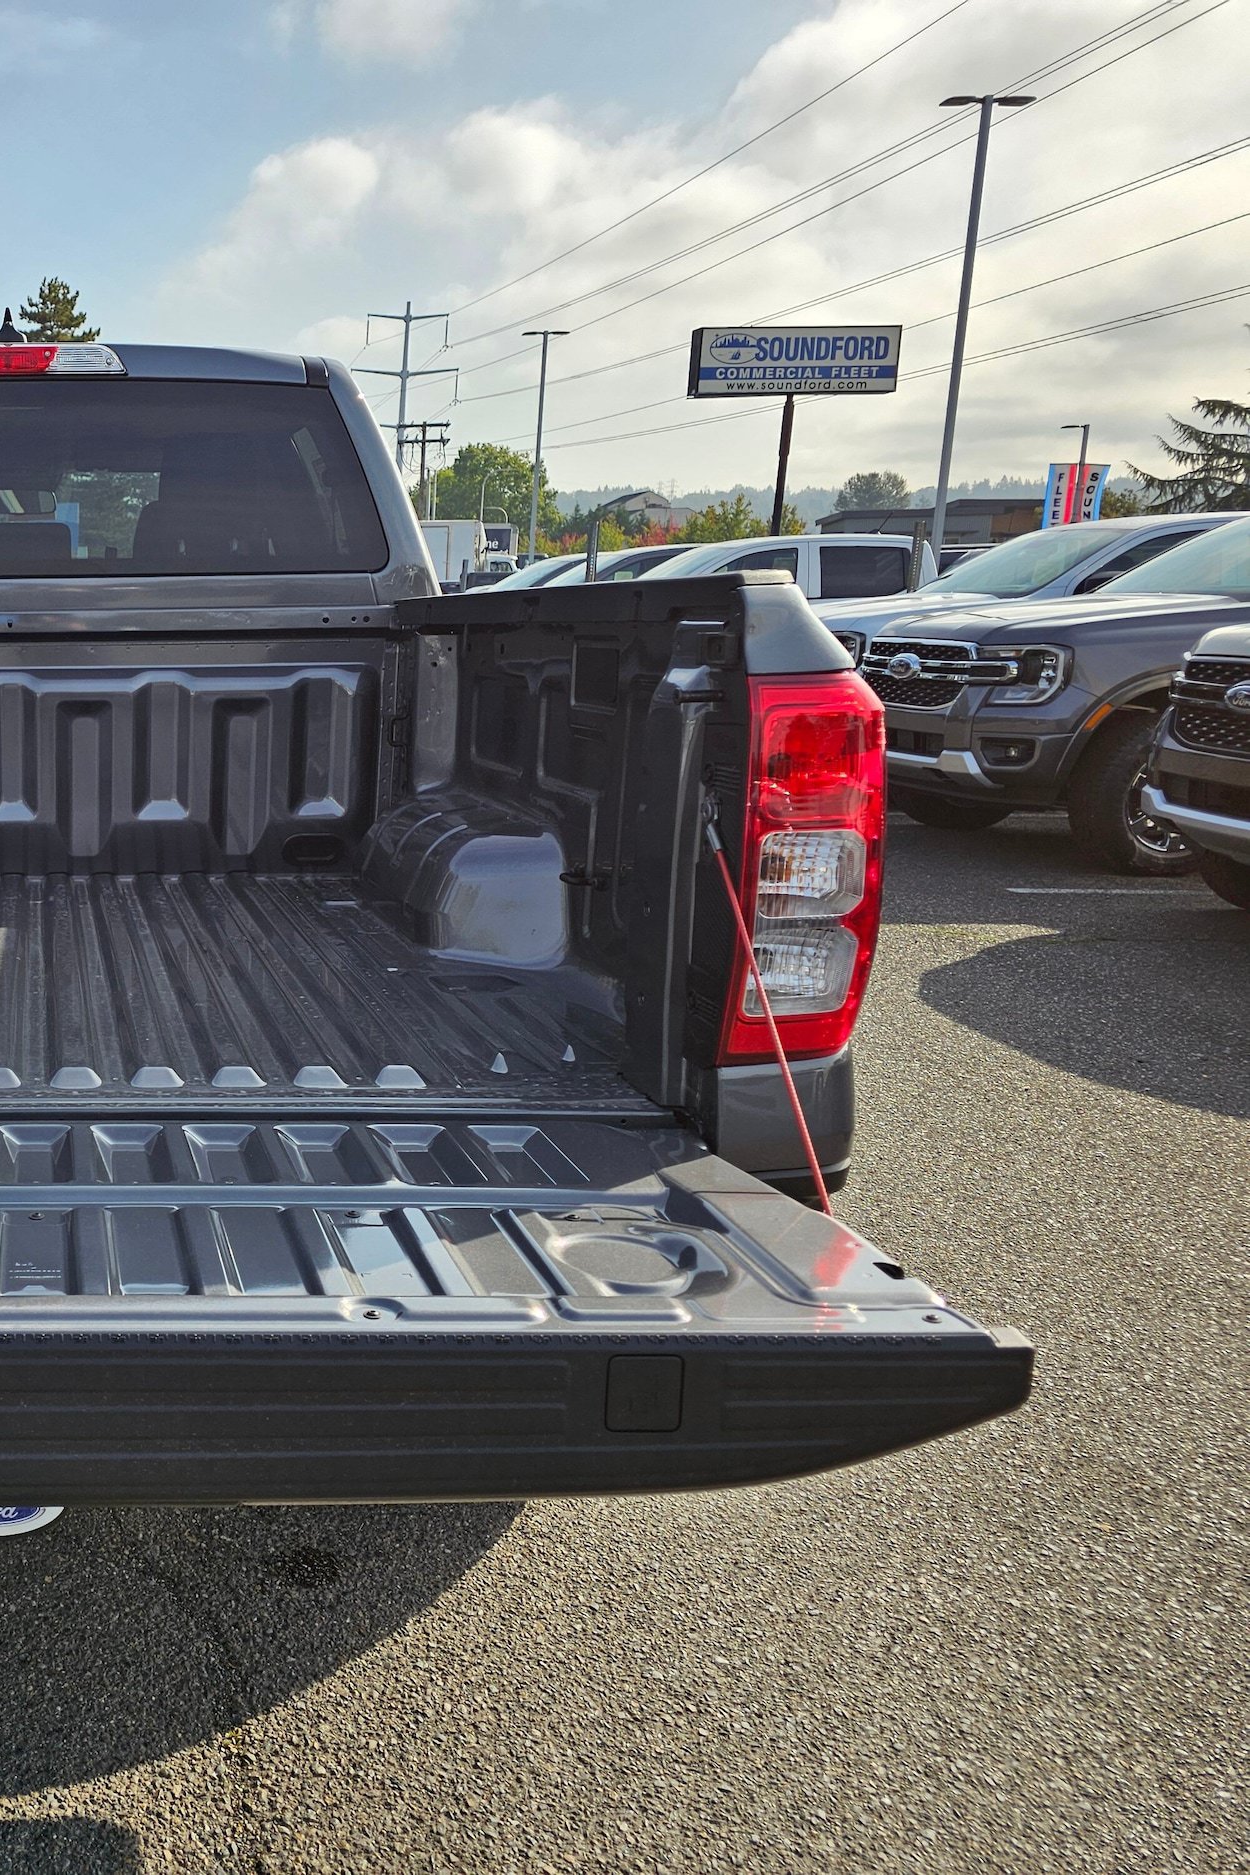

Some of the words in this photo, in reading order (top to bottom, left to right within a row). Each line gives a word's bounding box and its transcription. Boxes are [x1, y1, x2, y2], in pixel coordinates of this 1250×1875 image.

[755, 335, 890, 362] SOUNDFORD
[715, 367, 823, 380] COMMERCIAL
[830, 366, 880, 379] FLEET
[726, 379, 868, 391] www.soundford.com
